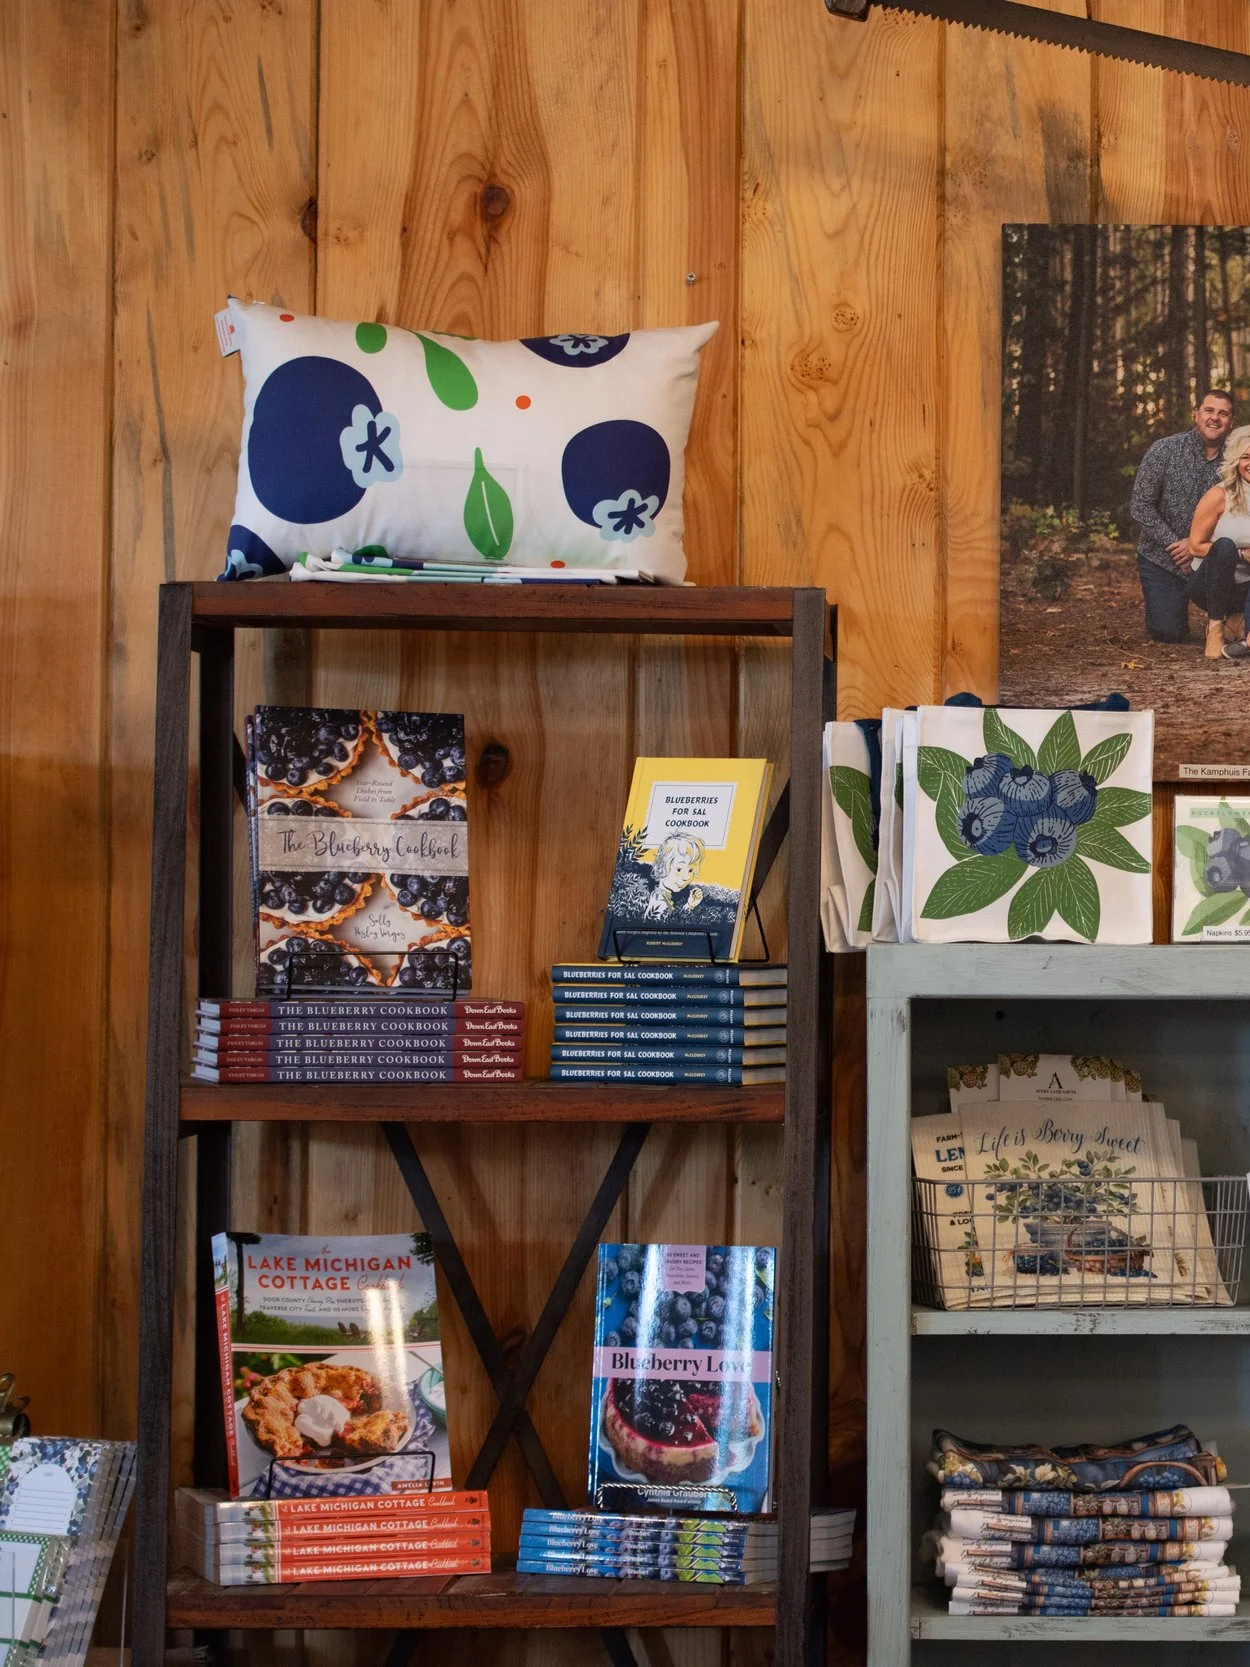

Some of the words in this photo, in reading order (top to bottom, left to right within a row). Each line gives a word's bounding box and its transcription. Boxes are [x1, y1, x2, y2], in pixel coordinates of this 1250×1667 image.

[1201, 768, 1240, 776] Kamphuis
[666, 796, 718, 804] BLUEBERRIES
[277, 830, 306, 854] The
[308, 830, 390, 862] Blueberry
[396, 832, 463, 859] Cookbook
[1206, 930, 1232, 938] Napkins
[608, 971, 621, 979] FOR
[564, 991, 607, 999] BLUEBERRIES
[278, 1006, 303, 1015] THE
[307, 1006, 376, 1015] BLUEBERRY
[380, 1006, 448, 1015] COOKBOOK
[641, 1012, 677, 1020] COOKBOOK
[280, 1022, 304, 1031] THE
[308, 1022, 377, 1031] BLUEBERRY
[381, 1022, 449, 1031] COOKBOOK
[277, 1039, 301, 1048] THE
[305, 1039, 375, 1048] BLUEBERRY
[378, 1039, 447, 1048] COOKBOOK
[607, 1050, 621, 1058] FOR
[624, 1050, 635, 1058] SAL
[277, 1070, 302, 1080] THE
[306, 1070, 375, 1080] BLUEBERRY
[379, 1070, 447, 1080] COOKBOOK
[974, 1125, 1012, 1160] Life
[1014, 1124, 1025, 1147] is
[1033, 1119, 1086, 1154] Berry
[1090, 1126, 1143, 1154] Sweet
[248, 1256, 296, 1272] LAKE
[305, 1256, 412, 1272] MICHIGAN
[258, 1275, 350, 1290] COTTAGE
[357, 1272, 405, 1290] Cookbk
[611, 1353, 702, 1376] Blueberry
[706, 1355, 749, 1374] Love
[226, 1388, 234, 1435] COTTAGE
[423, 1480, 445, 1488] LVIN
[290, 1501, 317, 1513] LAKE
[320, 1500, 374, 1511] MICHIGAN
[378, 1498, 425, 1509] COTTAGE
[293, 1522, 320, 1533] LAKE
[323, 1521, 377, 1532] MICHIGAN
[380, 1519, 428, 1530] COTTAGE
[549, 1526, 583, 1537] Blueberry
[293, 1543, 320, 1556] LAKE
[323, 1542, 377, 1554] MICHIGAN
[380, 1540, 428, 1551] COTTAGE
[547, 1538, 581, 1549] Blueberry
[546, 1564, 581, 1576] Blueberry
